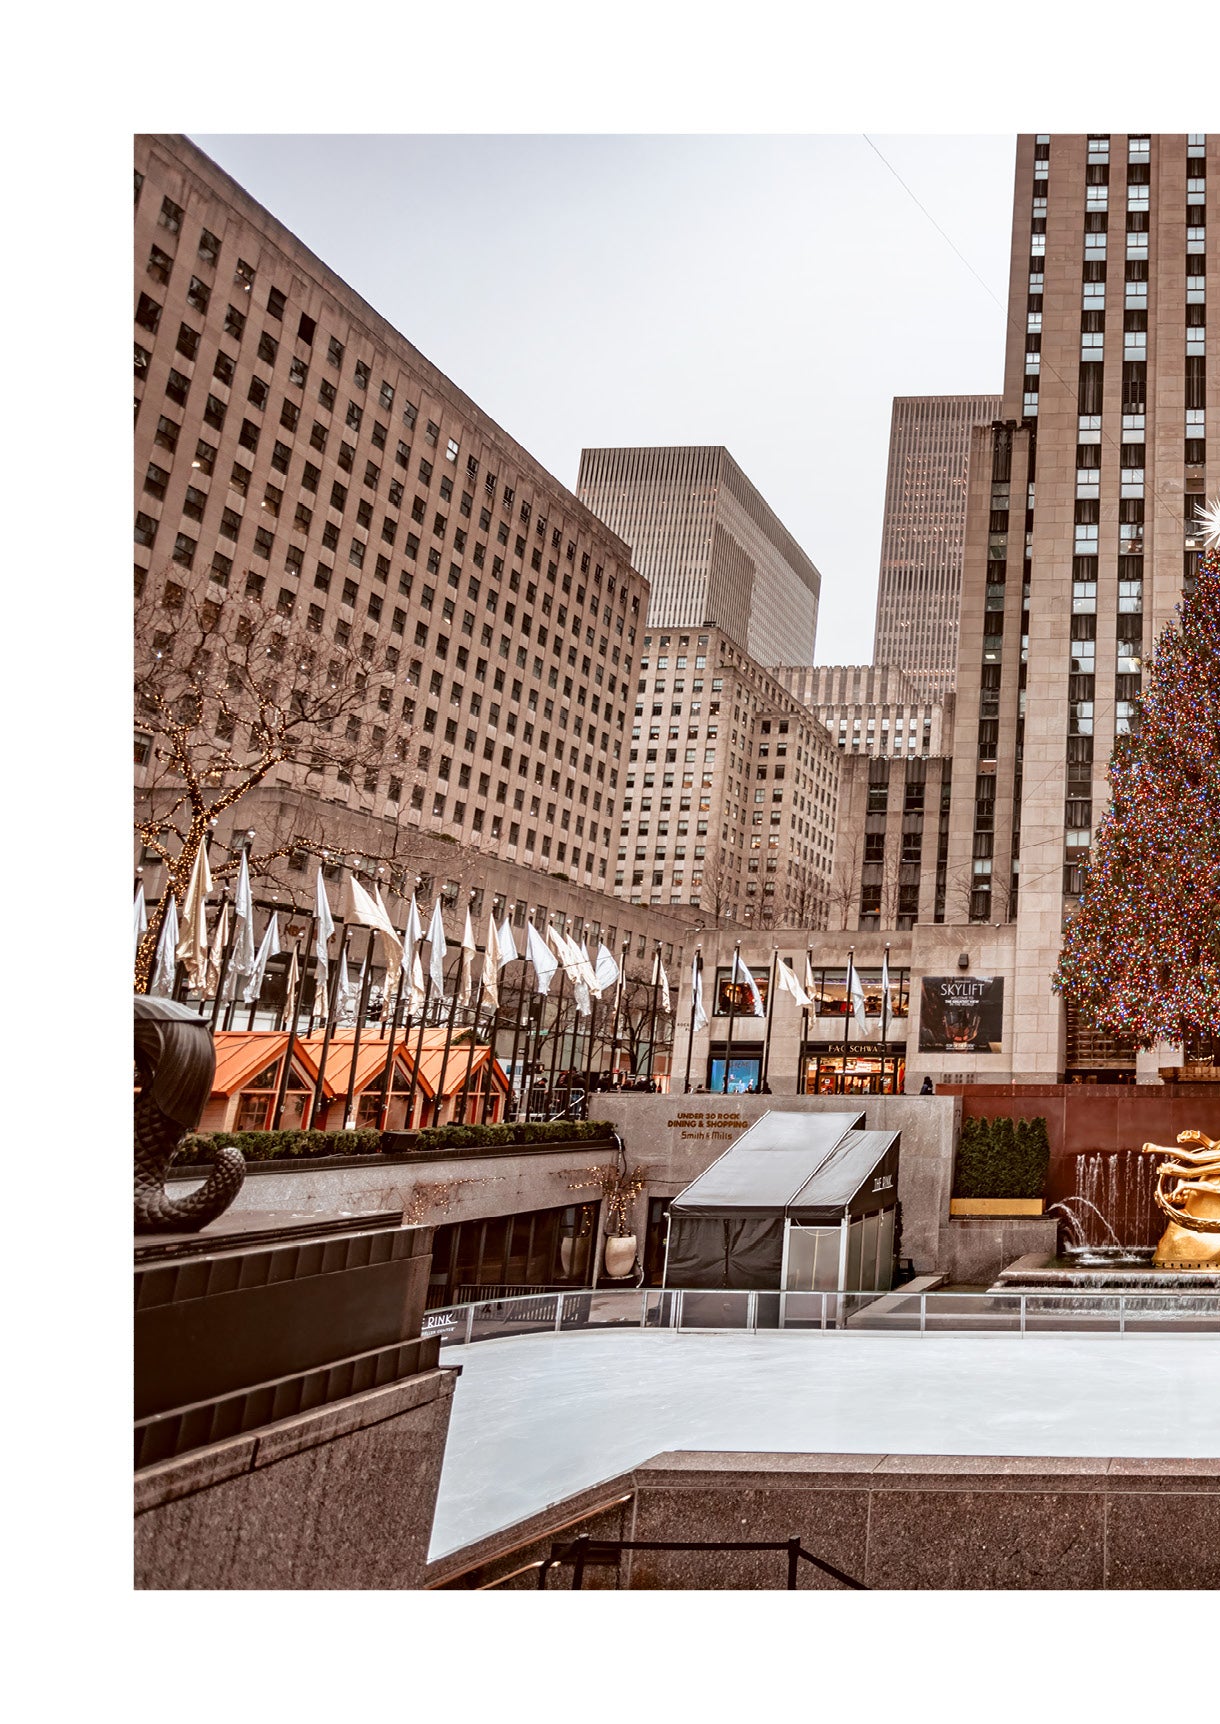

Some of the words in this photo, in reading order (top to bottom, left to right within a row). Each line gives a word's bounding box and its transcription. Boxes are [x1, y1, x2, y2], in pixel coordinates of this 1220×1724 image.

[941, 984, 984, 995] SKYLIFT
[668, 1120, 696, 1128] DINING
[706, 1120, 748, 1128] SHOPPING
[681, 1131, 704, 1139] Smith
[712, 1131, 732, 1140] Mills
[428, 1313, 453, 1328] RINK
